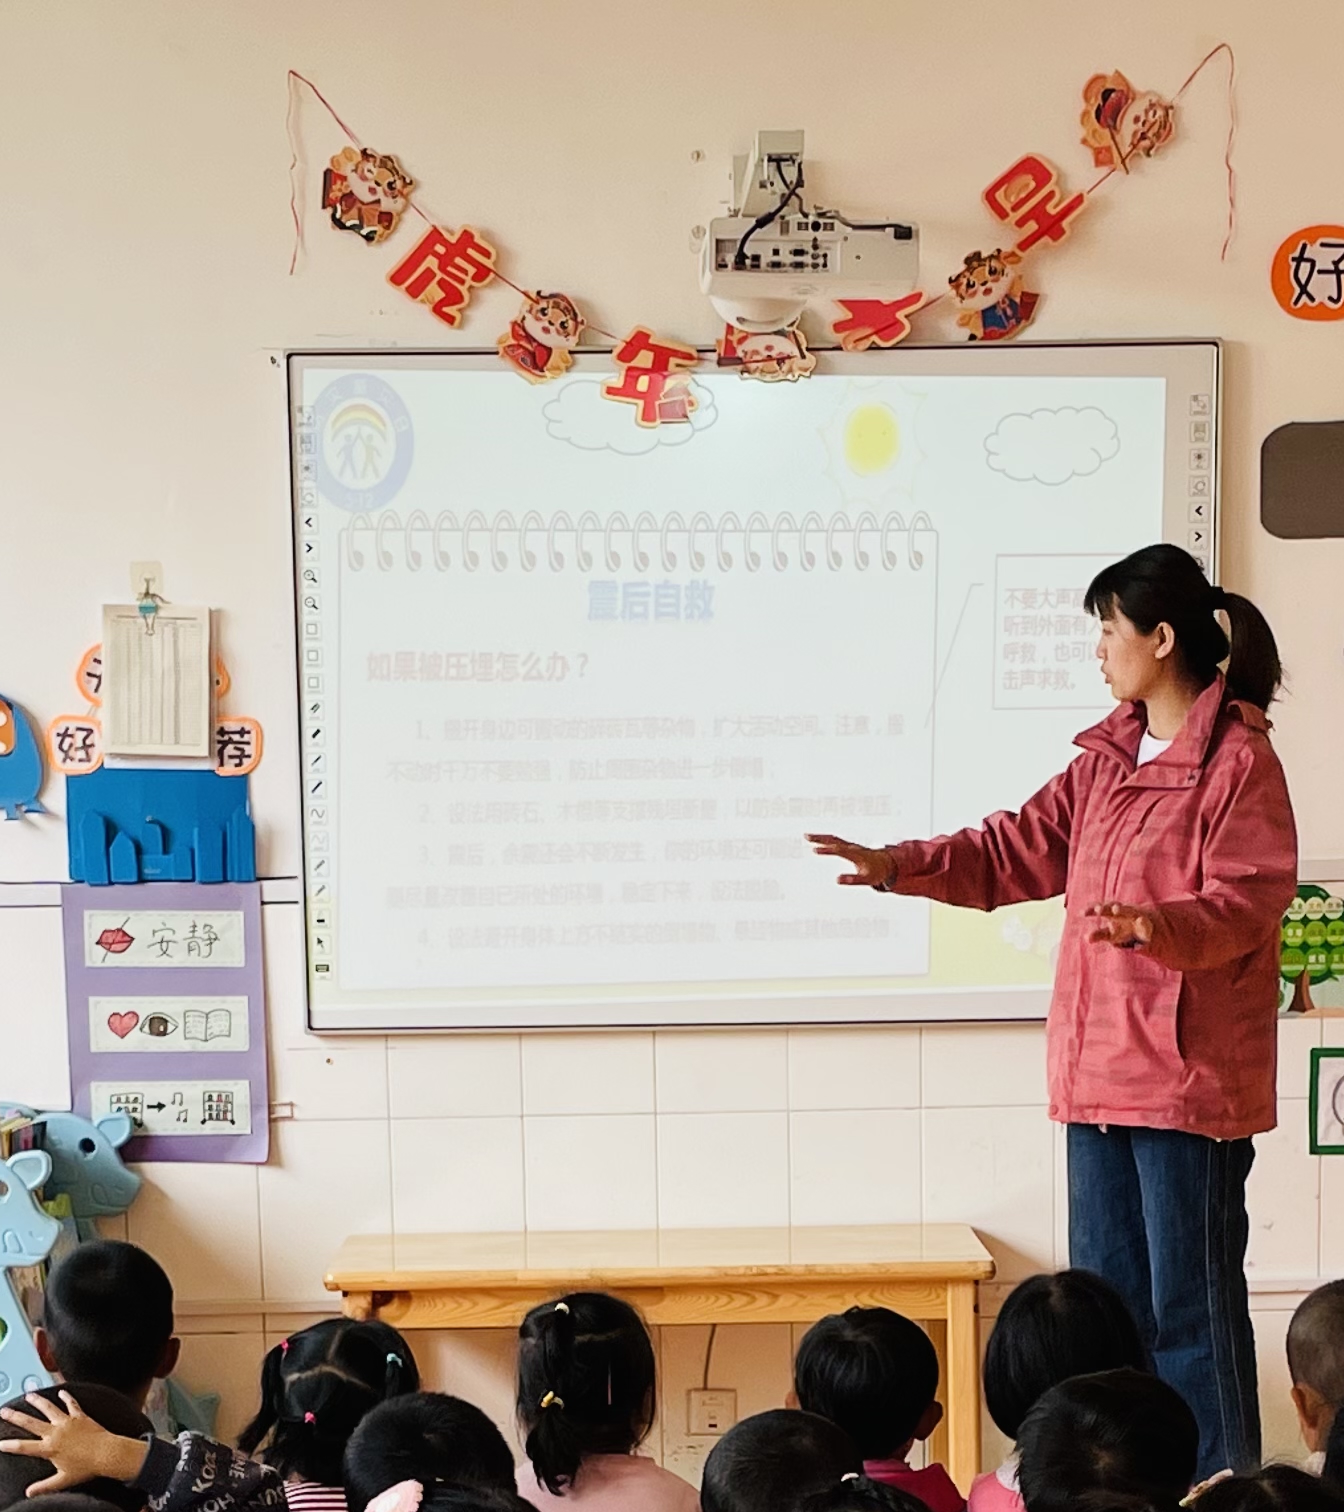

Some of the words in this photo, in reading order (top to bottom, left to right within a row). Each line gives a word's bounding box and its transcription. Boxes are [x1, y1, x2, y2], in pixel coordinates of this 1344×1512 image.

[586, 579, 716, 621] 震后自救
[147, 921, 221, 960] 安静
